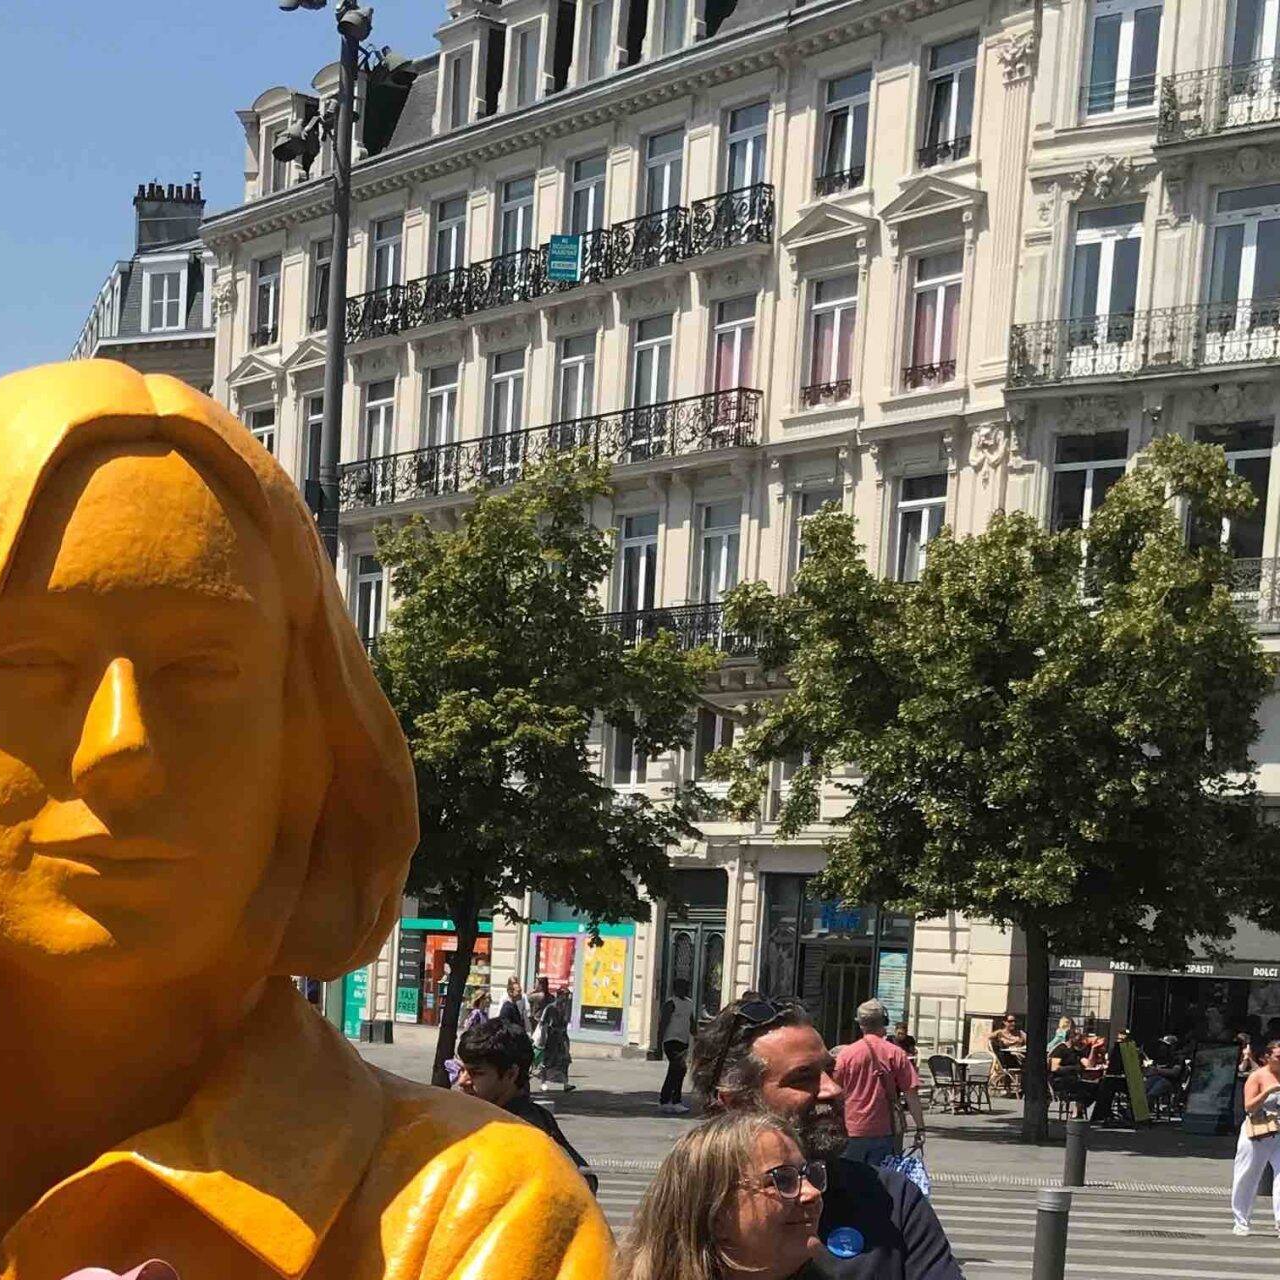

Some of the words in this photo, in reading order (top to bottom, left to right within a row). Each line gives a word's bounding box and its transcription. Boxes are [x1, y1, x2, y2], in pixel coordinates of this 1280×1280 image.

[1059, 958, 1082, 968] PIZZA
[1252, 966, 1278, 978] DOLCI
[401, 990, 415, 1001] TAX
[398, 1001, 416, 1011] FREE
